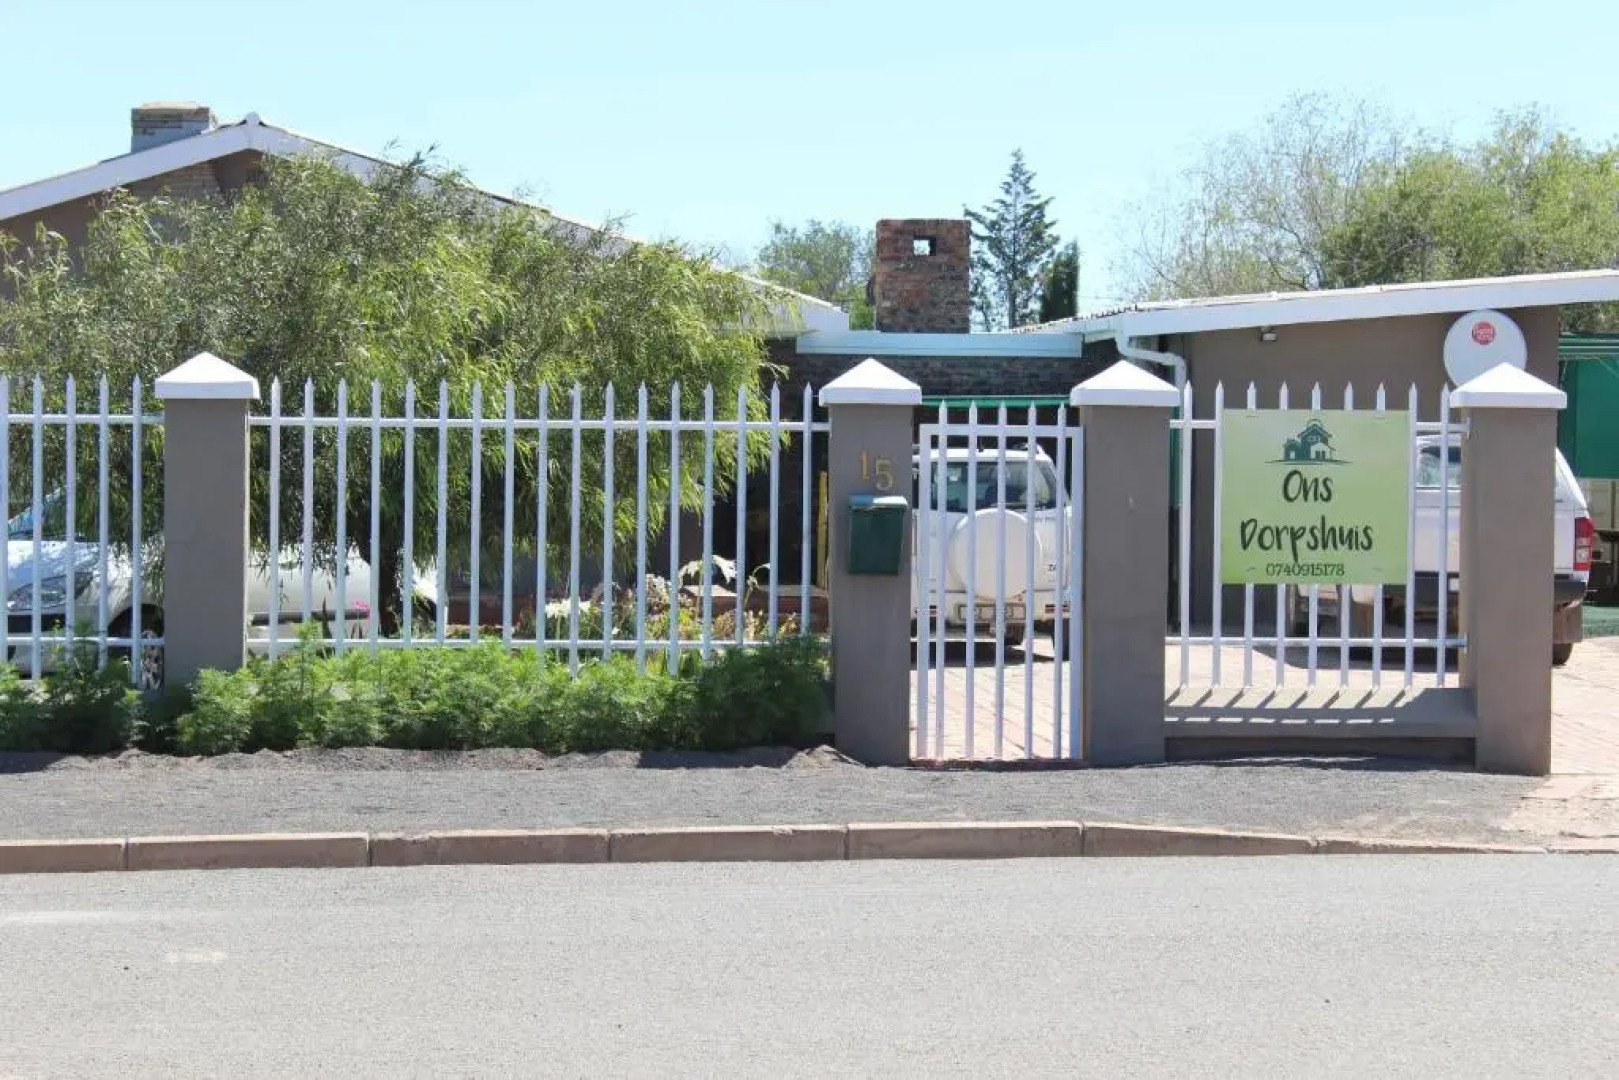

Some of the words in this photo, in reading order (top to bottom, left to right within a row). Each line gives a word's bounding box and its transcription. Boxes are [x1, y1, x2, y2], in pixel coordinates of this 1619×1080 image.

[861, 450, 894, 491] 15
[1283, 469, 1333, 502] Ons
[1240, 514, 1373, 563] Dorpshuis
[1266, 563, 1345, 576] 0740915178
